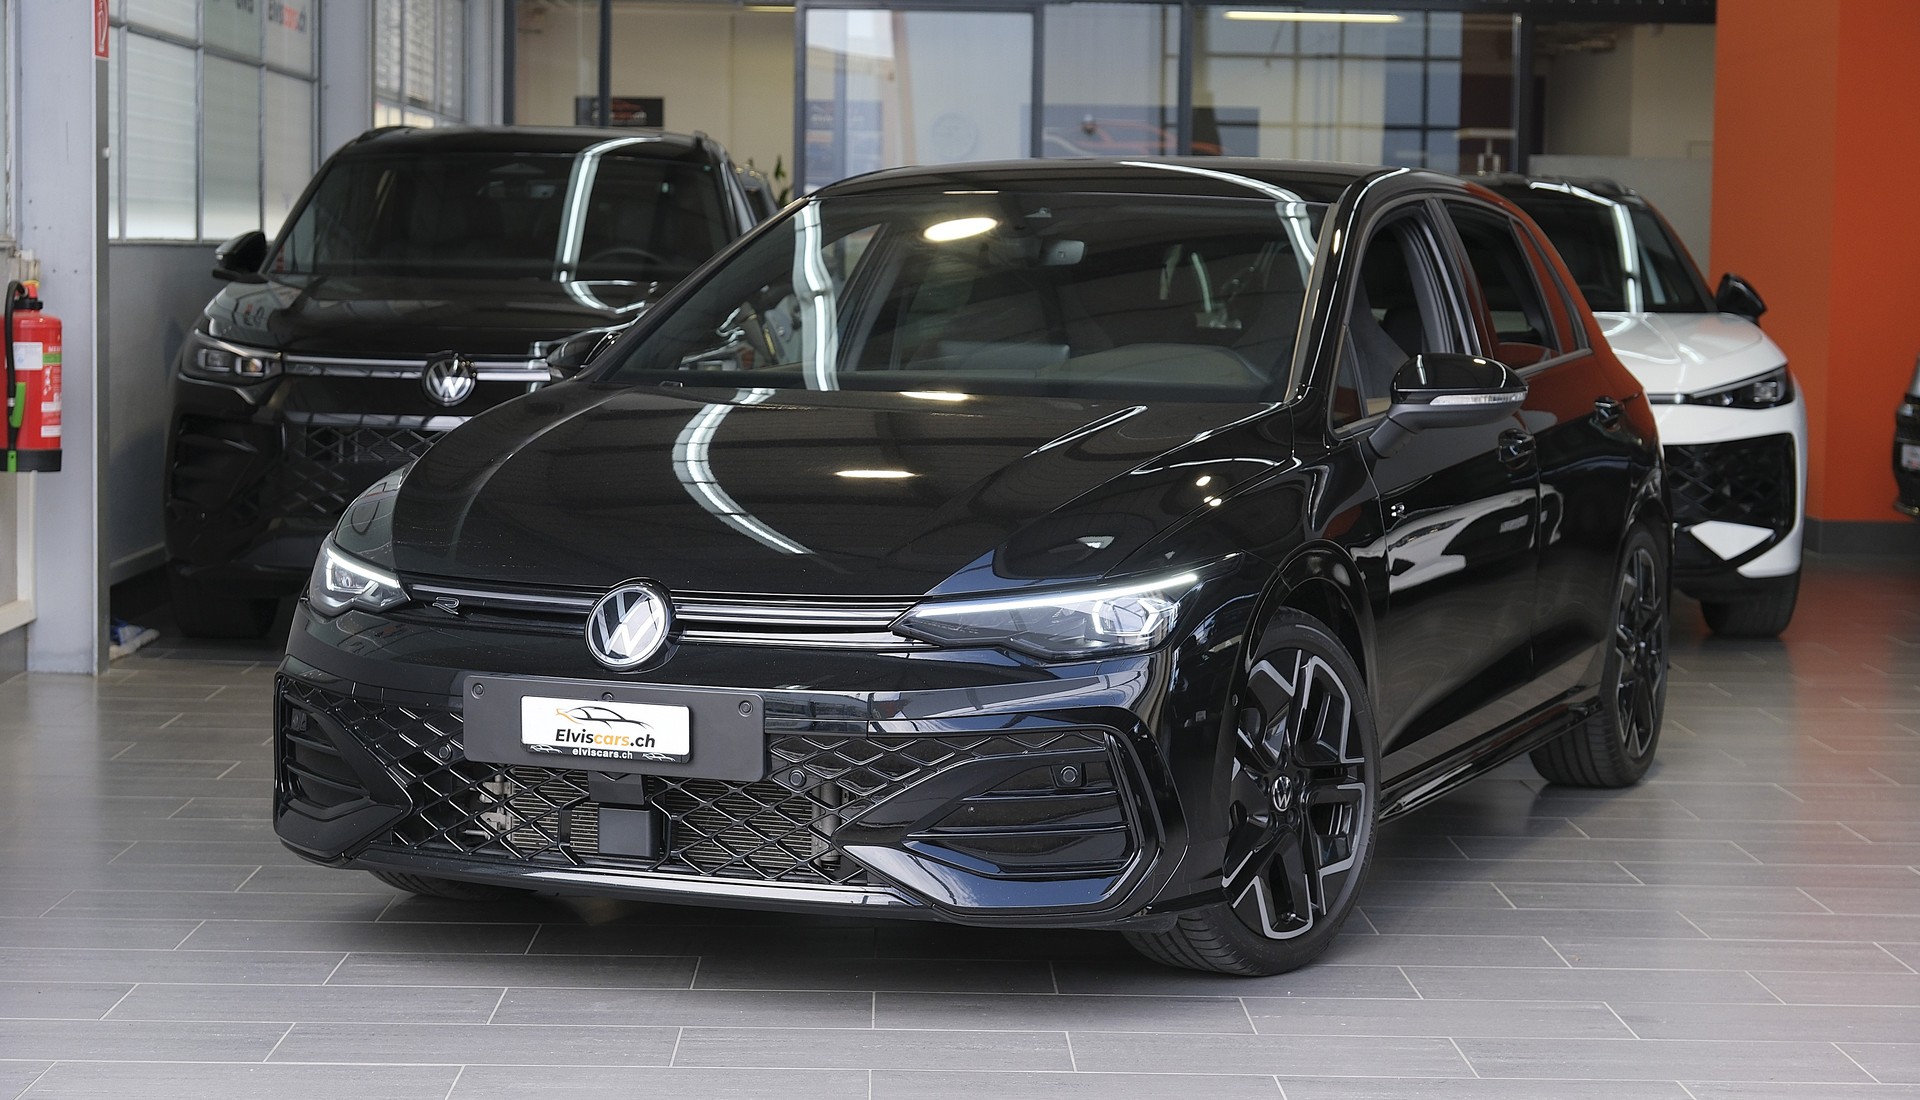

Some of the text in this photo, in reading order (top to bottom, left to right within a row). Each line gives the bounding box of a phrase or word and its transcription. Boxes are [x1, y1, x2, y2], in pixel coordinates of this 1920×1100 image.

[432, 597, 460, 615] R
[588, 585, 668, 665] VW
[555, 728, 656, 748] Elviscars.ch
[572, 747, 633, 760] elviscars.ch
